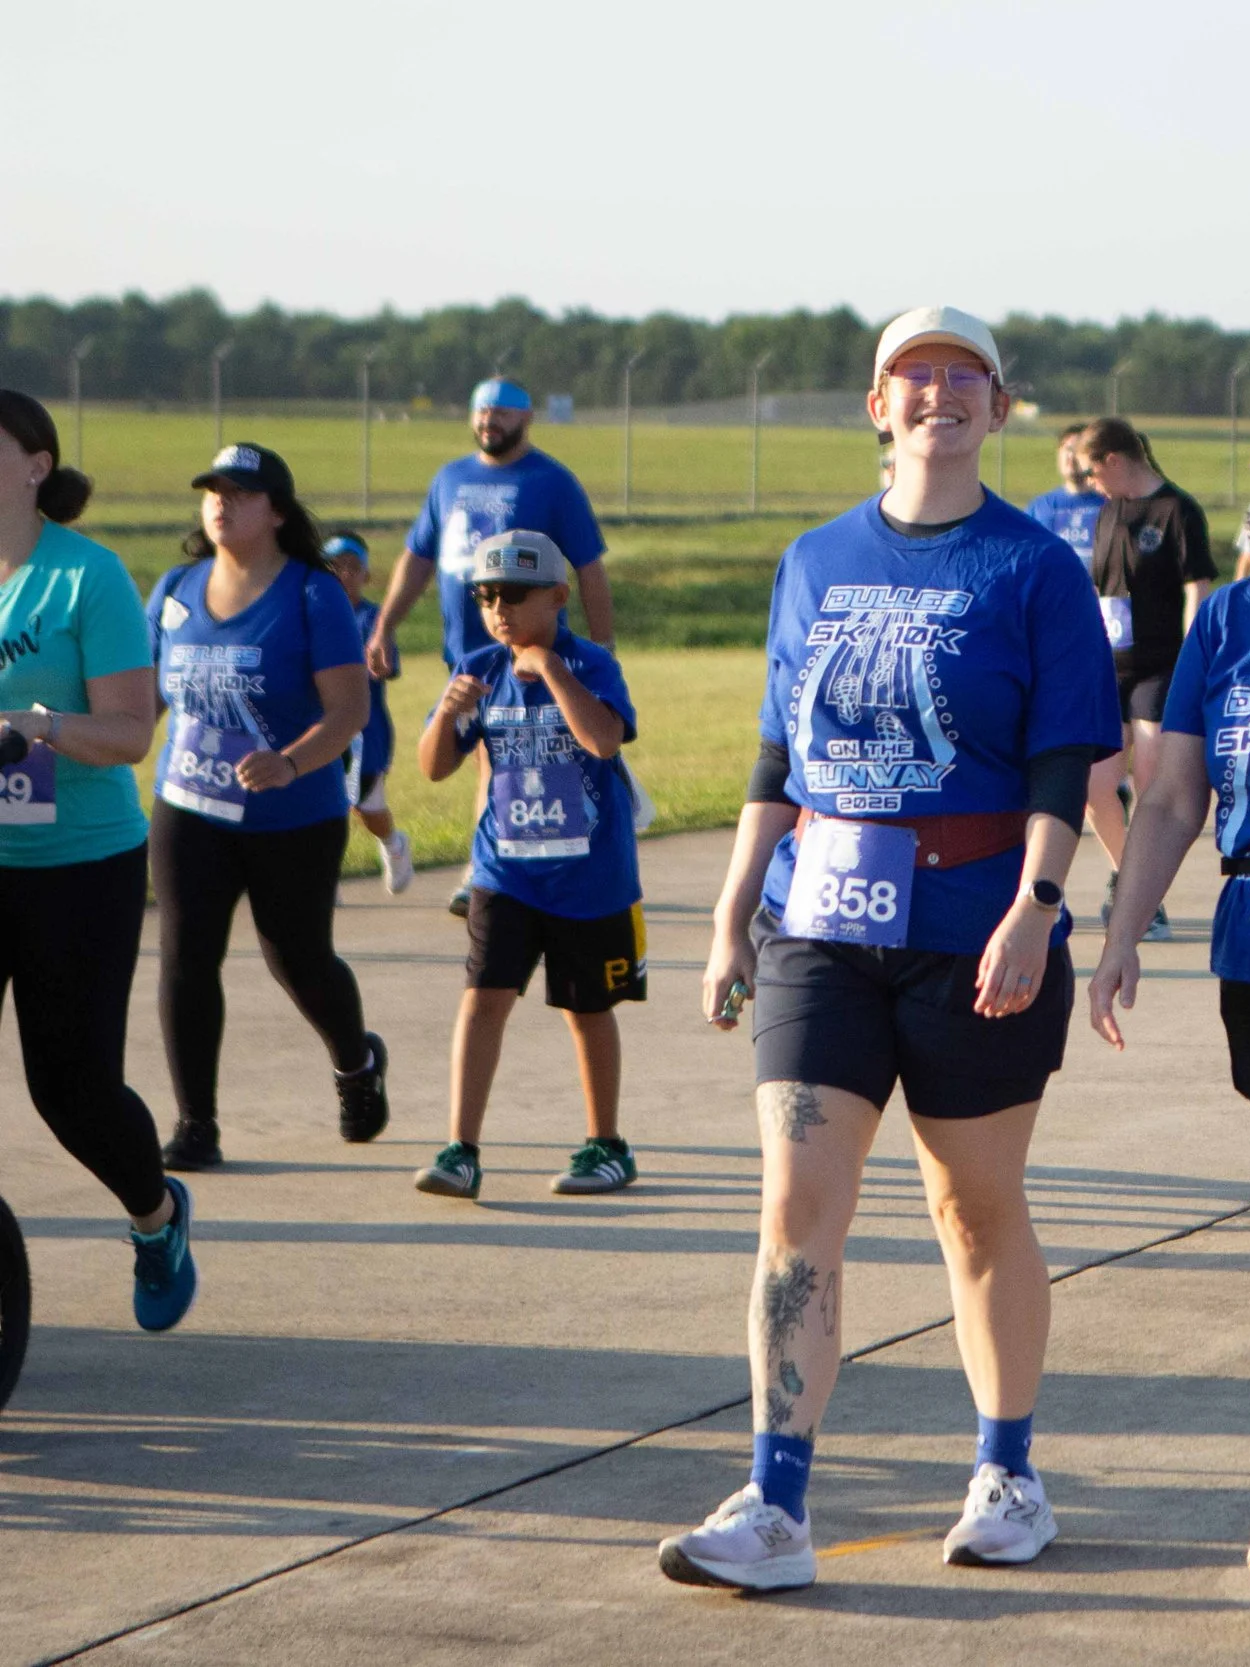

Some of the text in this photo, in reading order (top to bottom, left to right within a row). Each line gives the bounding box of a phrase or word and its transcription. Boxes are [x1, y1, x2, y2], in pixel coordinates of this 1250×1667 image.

[821, 585, 973, 617] DULLES
[806, 621, 968, 656] 5K 10K
[215, 674, 266, 694] 10K
[828, 739, 914, 759] ON THE
[179, 751, 234, 787] 843
[804, 760, 957, 793] RUNWAY
[510, 799, 567, 826] 844
[836, 793, 902, 813] 2026
[814, 873, 898, 922] 358
